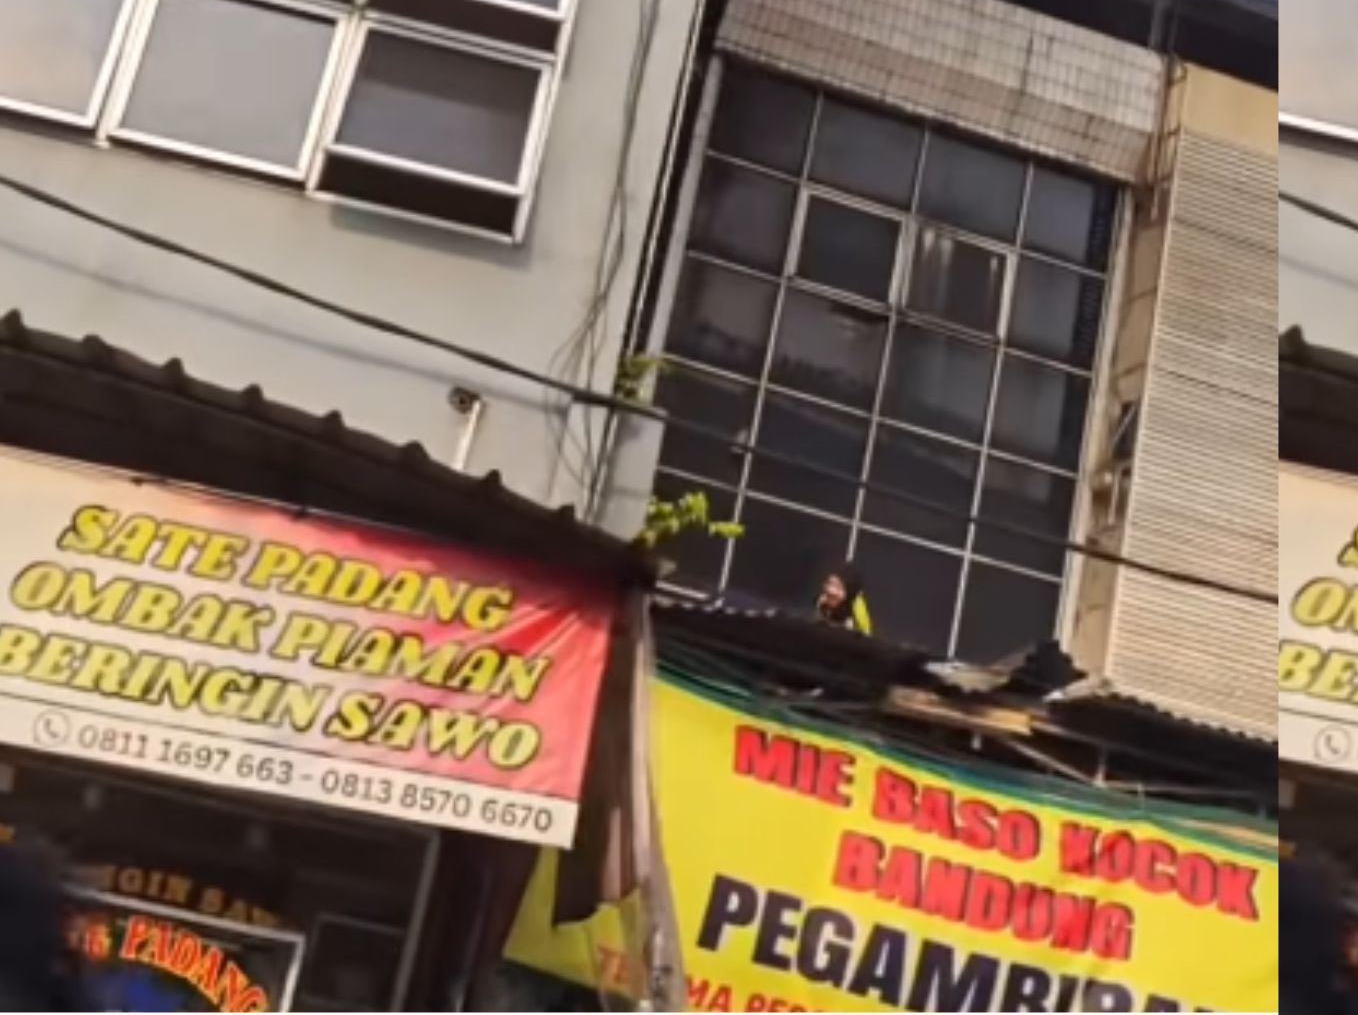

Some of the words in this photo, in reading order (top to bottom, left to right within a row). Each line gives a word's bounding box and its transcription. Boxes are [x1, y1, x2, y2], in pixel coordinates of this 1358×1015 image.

[8, 561, 275, 653] OMBAK
[270, 609, 551, 704] PIAMAN
[57, 503, 251, 581] SATE
[245, 541, 515, 631] PADANG
[0, 623, 333, 733] BERINGIN
[322, 692, 542, 770] SAWO
[78, 723, 148, 758] 0811
[158, 735, 230, 774] 1697
[236, 753, 294, 786] 663
[320, 765, 393, 807] 0813
[400, 780, 472, 820] 8570
[480, 793, 553, 833] 6670
[732, 723, 857, 809] MIE
[871, 767, 1041, 861] BASO
[1058, 821, 1260, 921] KOCOK
[832, 830, 1135, 962] BANDUNG
